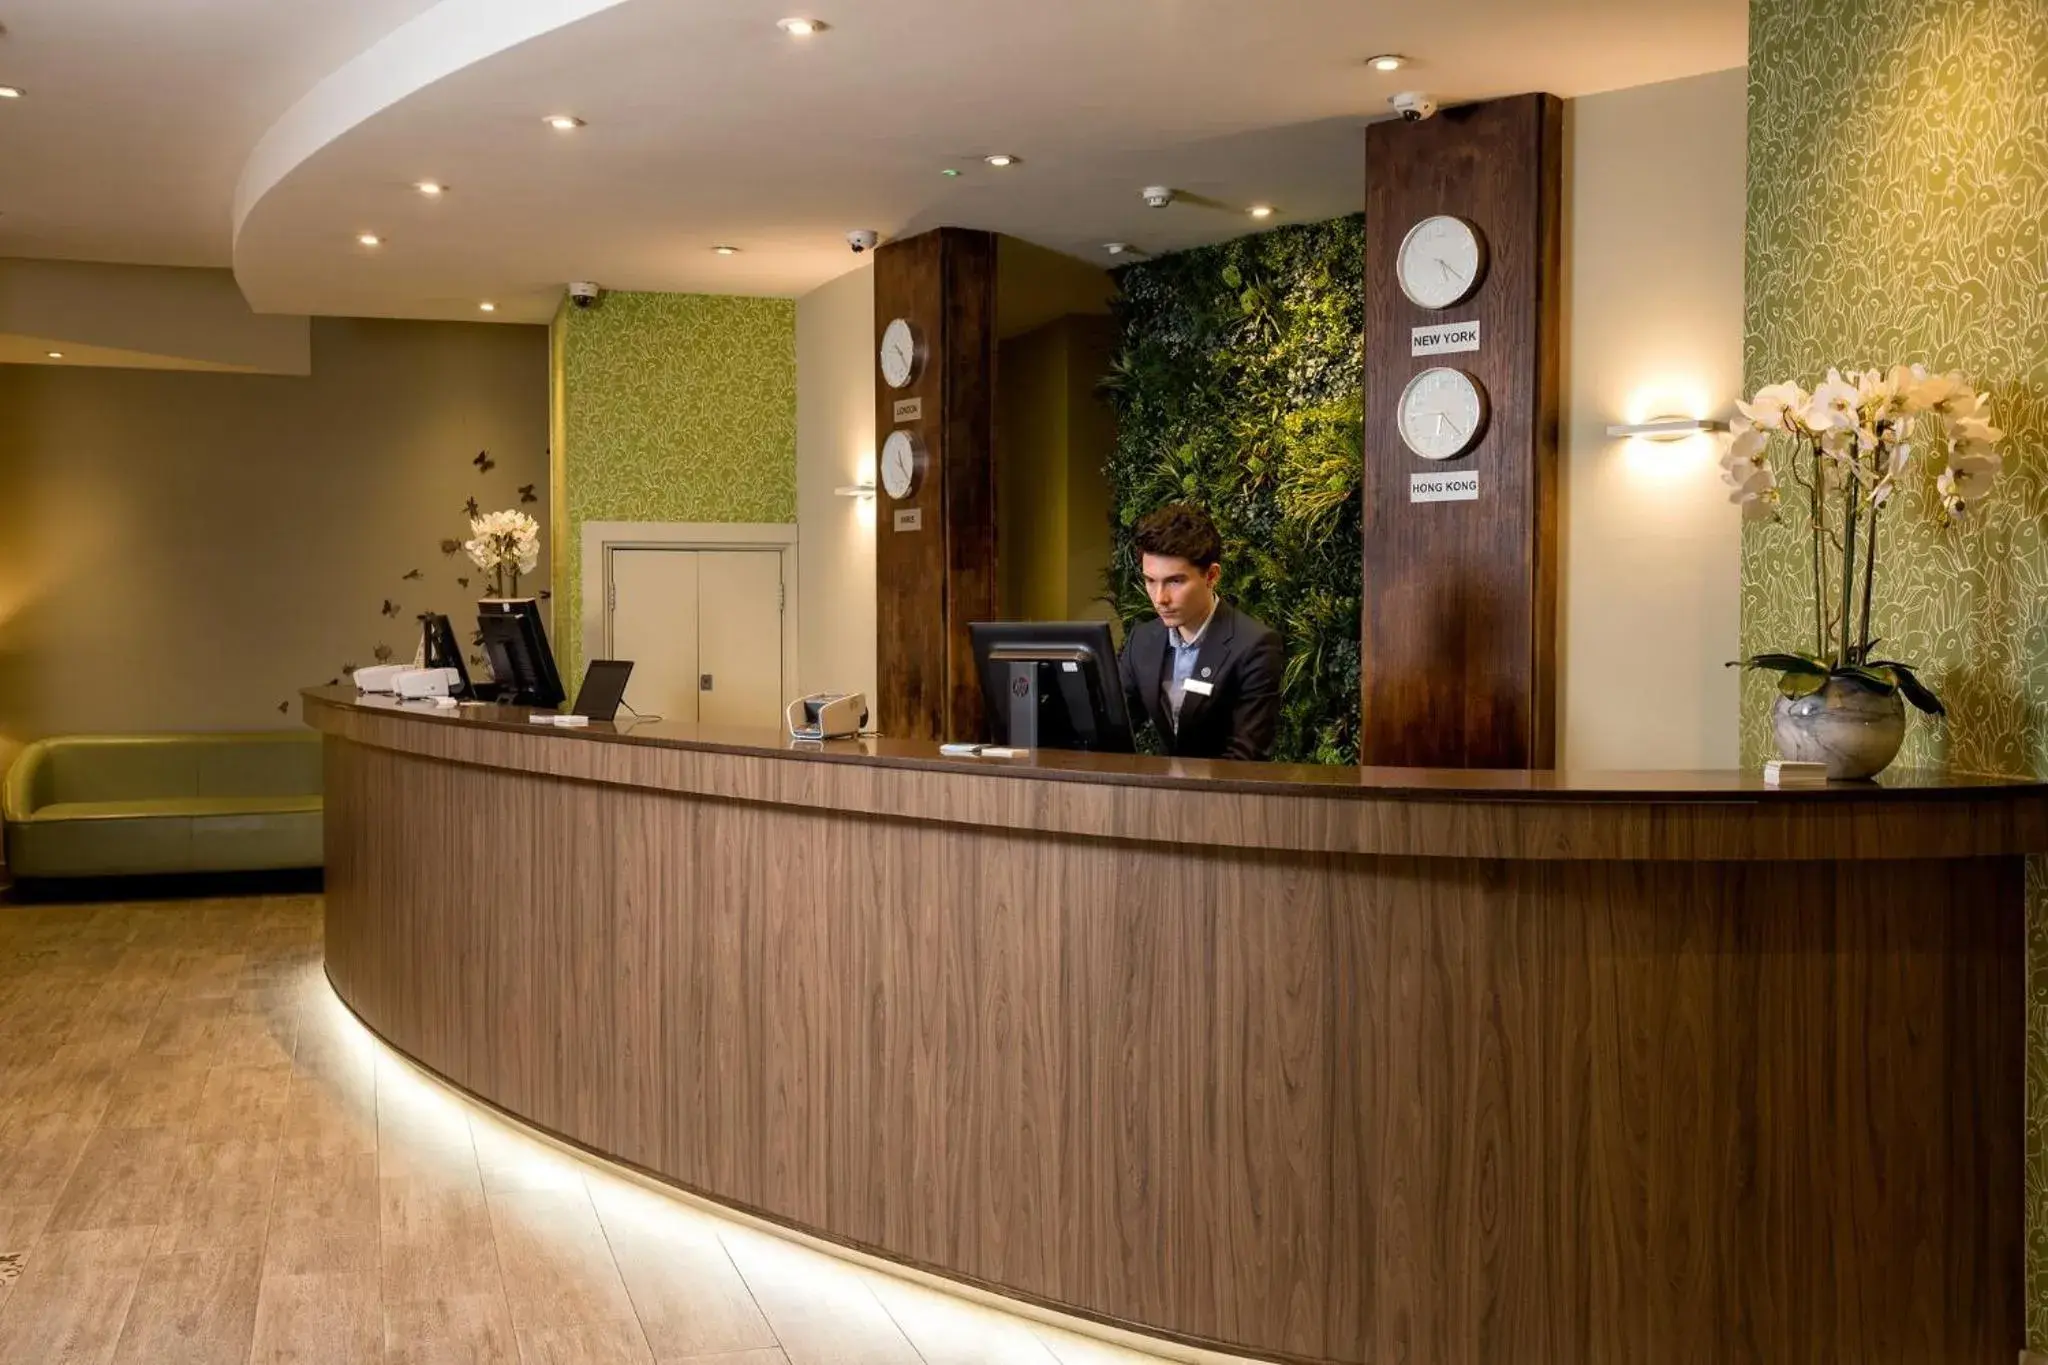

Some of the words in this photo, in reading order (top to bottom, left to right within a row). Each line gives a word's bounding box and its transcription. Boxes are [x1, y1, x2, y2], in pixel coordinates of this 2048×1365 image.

[1414, 334, 1441, 346] NEW
[1444, 331, 1476, 343] YORK
[1412, 483, 1442, 493] HONG
[1446, 481, 1477, 491] KONG
